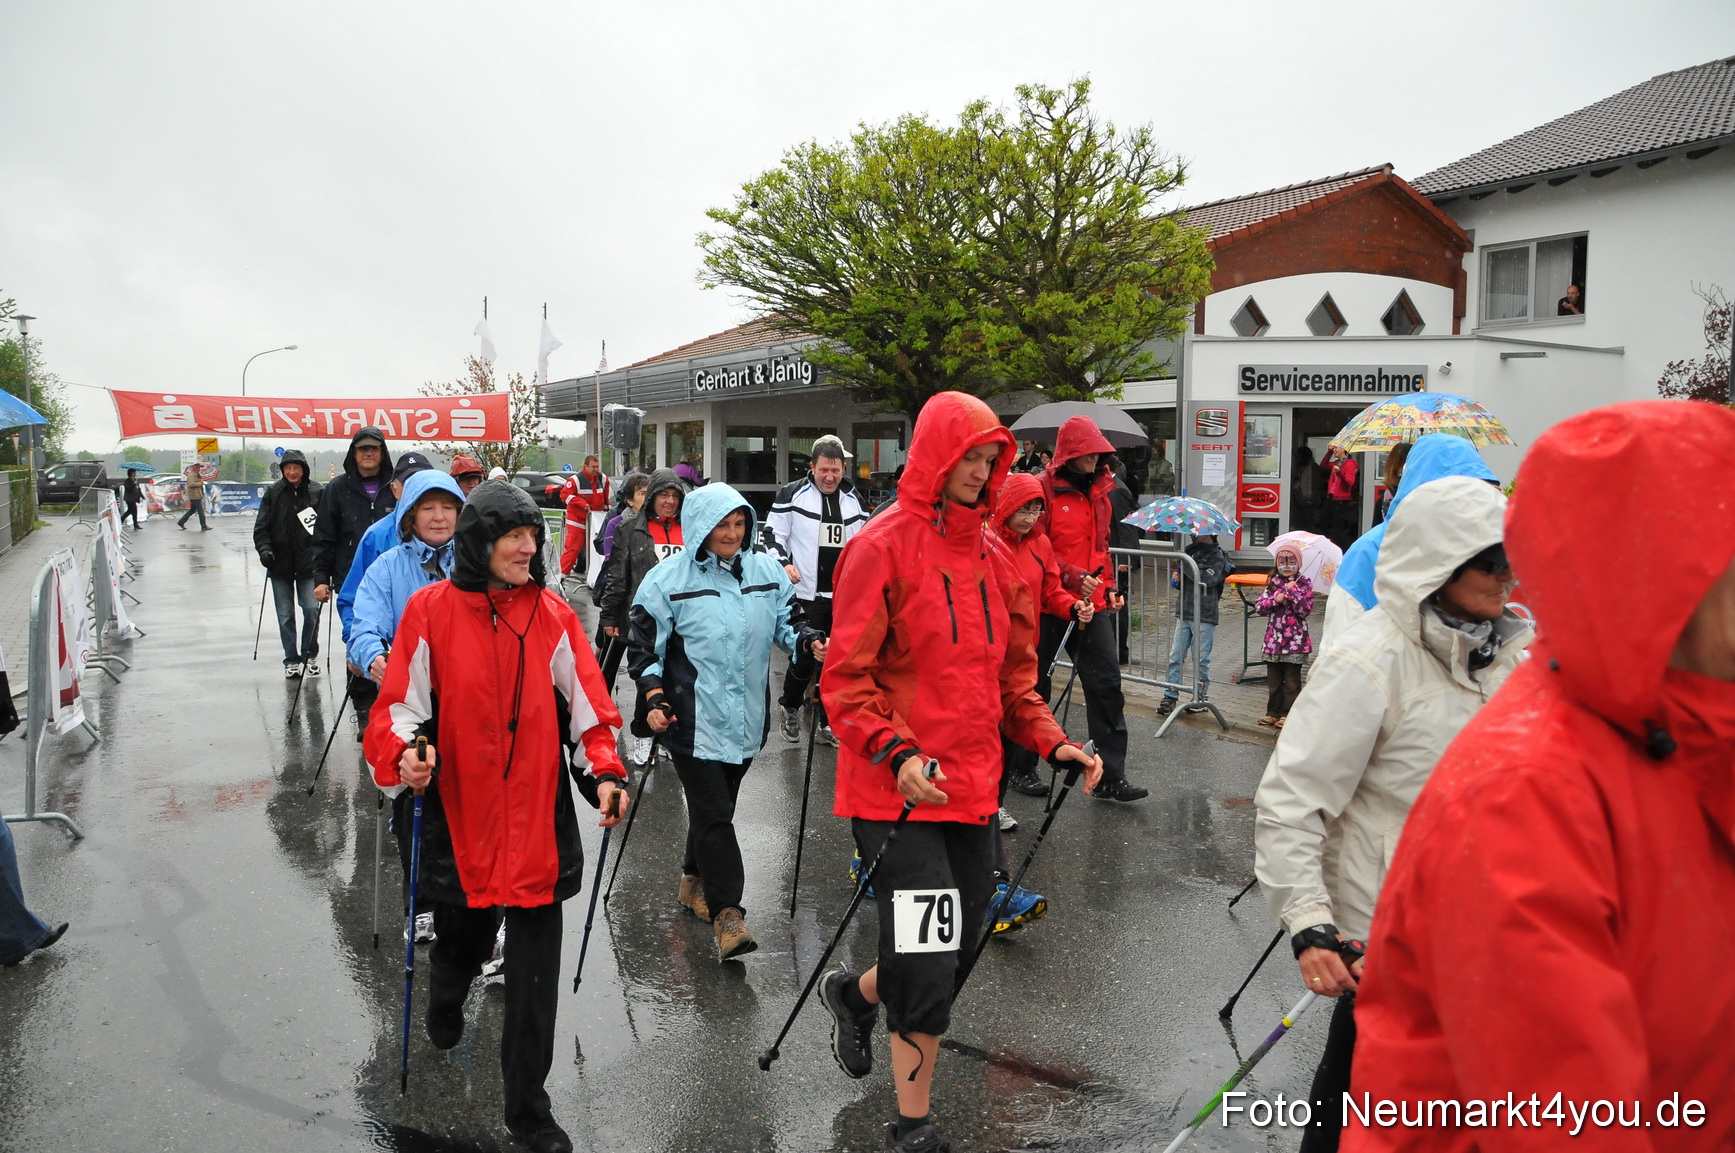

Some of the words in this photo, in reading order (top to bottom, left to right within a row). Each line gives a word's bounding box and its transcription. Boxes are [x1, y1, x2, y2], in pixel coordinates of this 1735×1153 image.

[695, 365, 750, 391] Gerhart
[754, 363, 765, 384] &
[769, 357, 812, 385] Jänig
[1241, 366, 1424, 392] Serviceannahme
[826, 525, 842, 544] 19
[913, 893, 954, 944] 79
